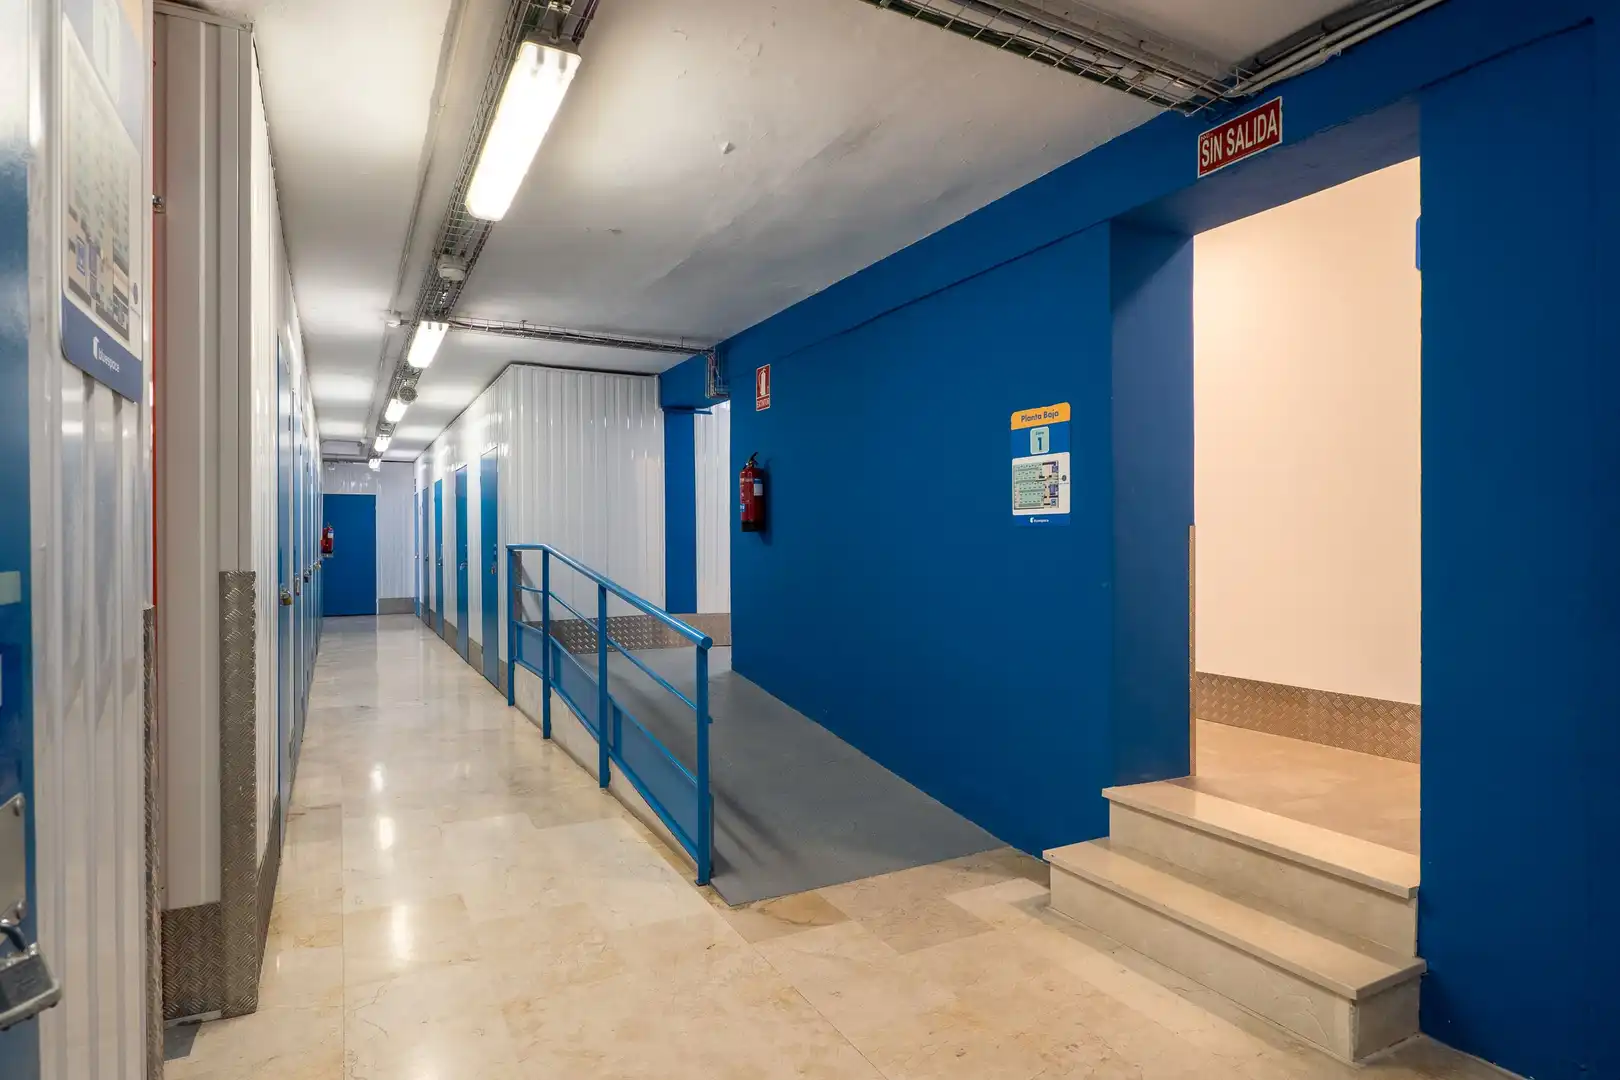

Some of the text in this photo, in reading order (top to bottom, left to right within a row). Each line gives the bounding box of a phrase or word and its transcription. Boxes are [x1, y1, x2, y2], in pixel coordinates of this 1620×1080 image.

[1202, 108, 1278, 167] SIN SALIDA
[1021, 409, 1059, 422] Planta Baja
[1037, 437, 1042, 451] 1
